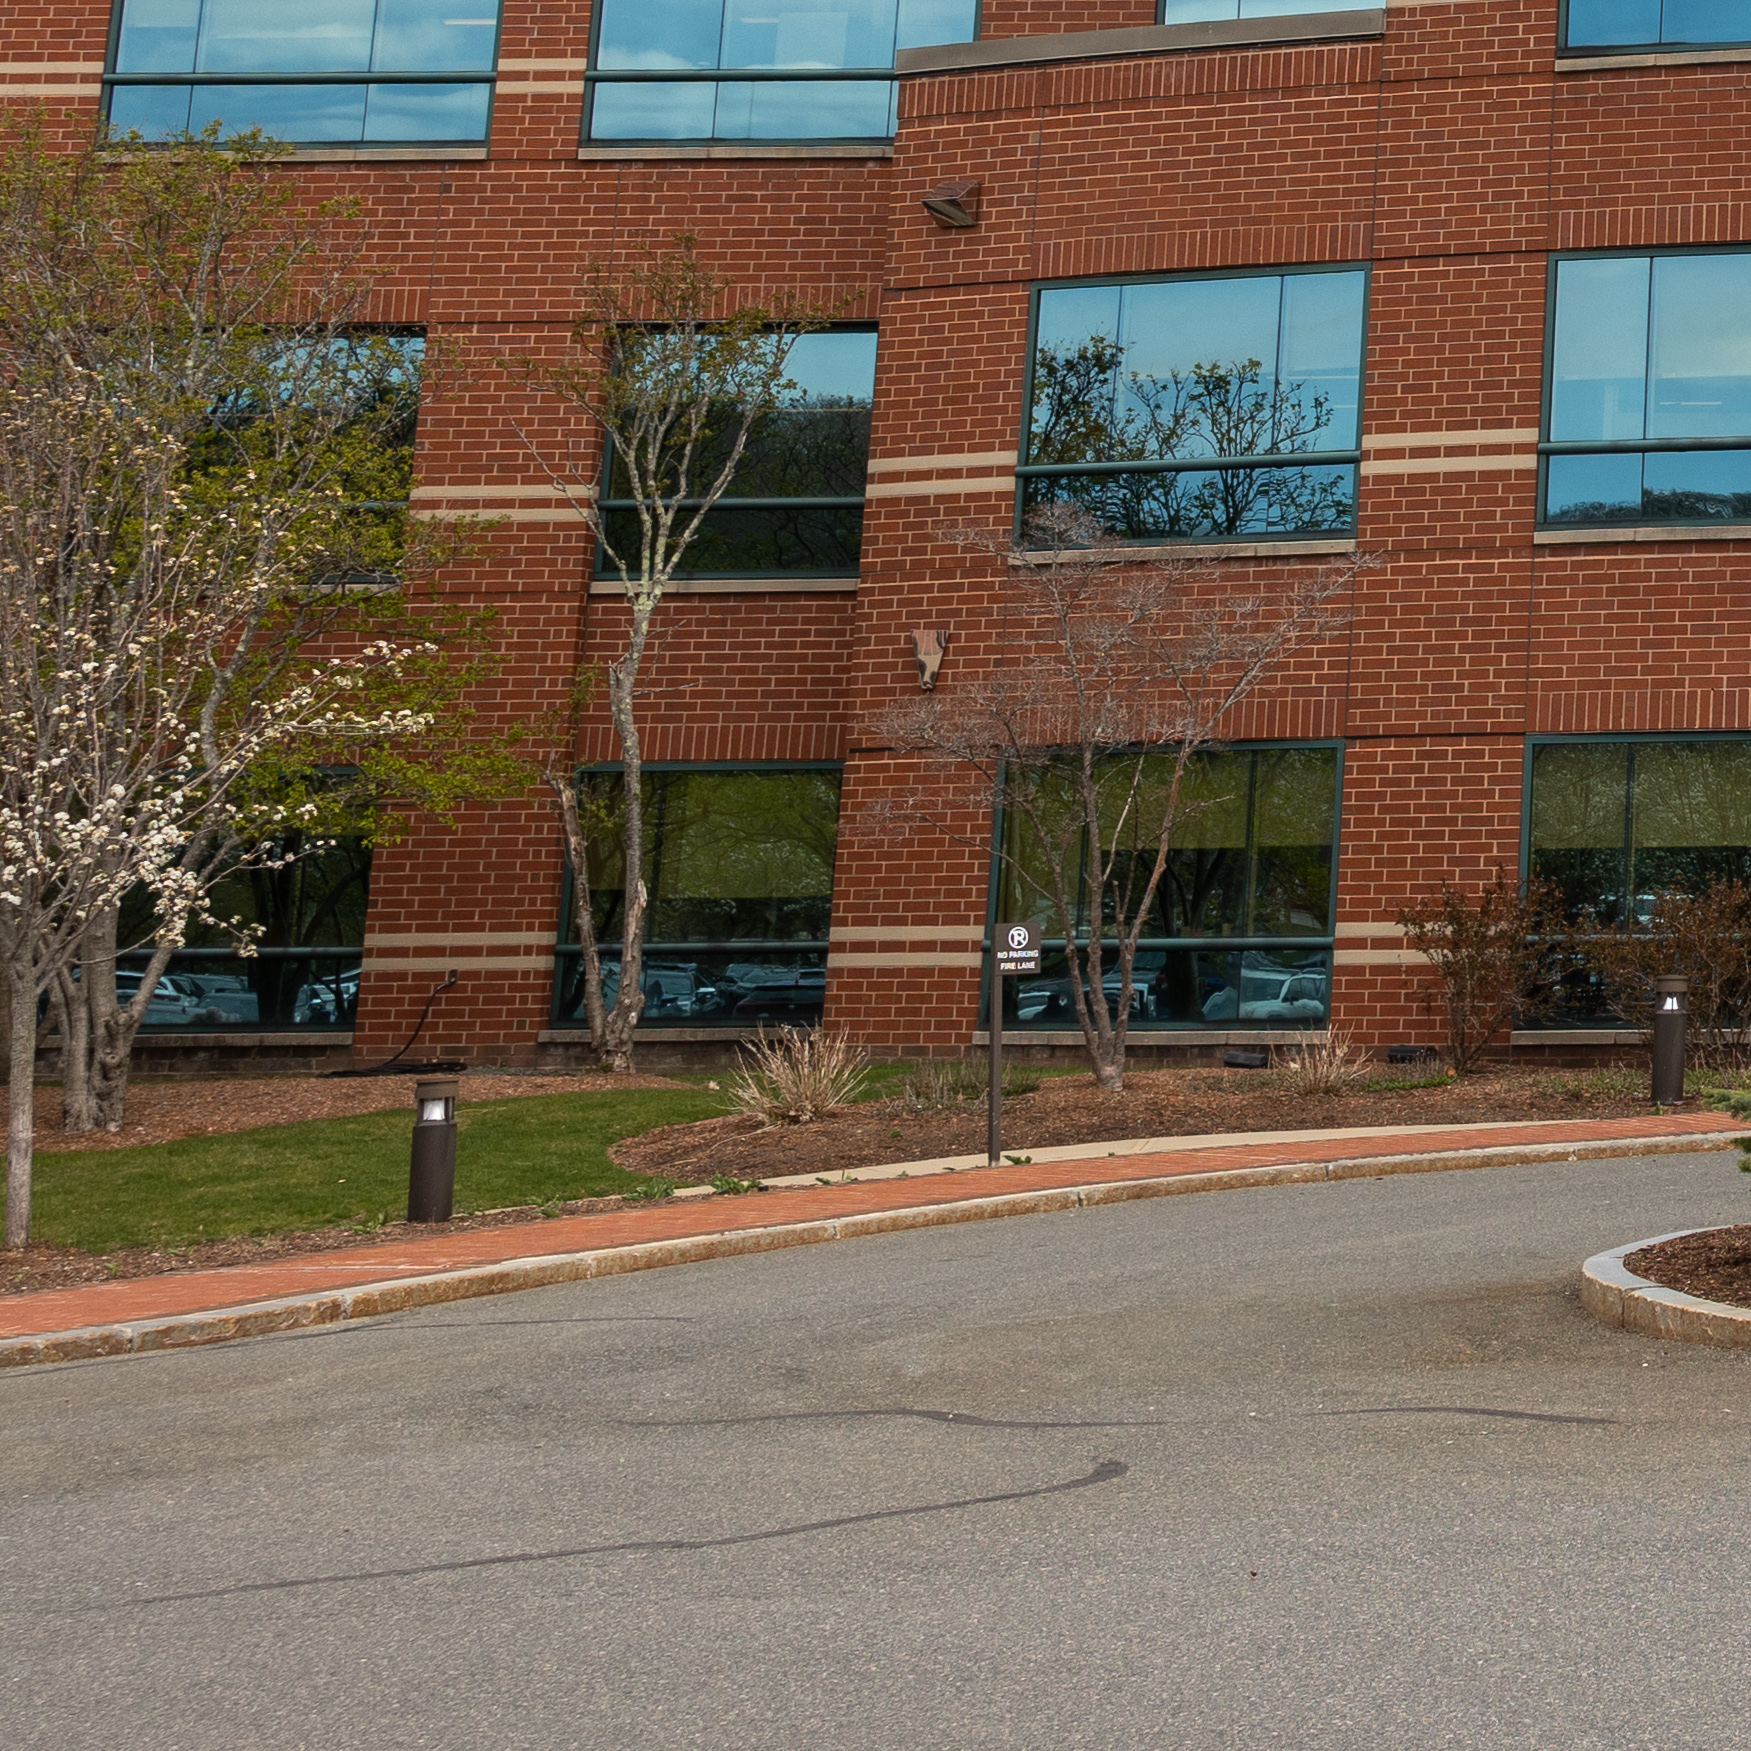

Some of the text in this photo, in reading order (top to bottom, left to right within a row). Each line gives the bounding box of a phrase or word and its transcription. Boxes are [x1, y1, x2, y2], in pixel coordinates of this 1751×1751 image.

[997, 950, 1039, 959] NO PARKING
[1000, 961, 1036, 970] FIRE LANE
